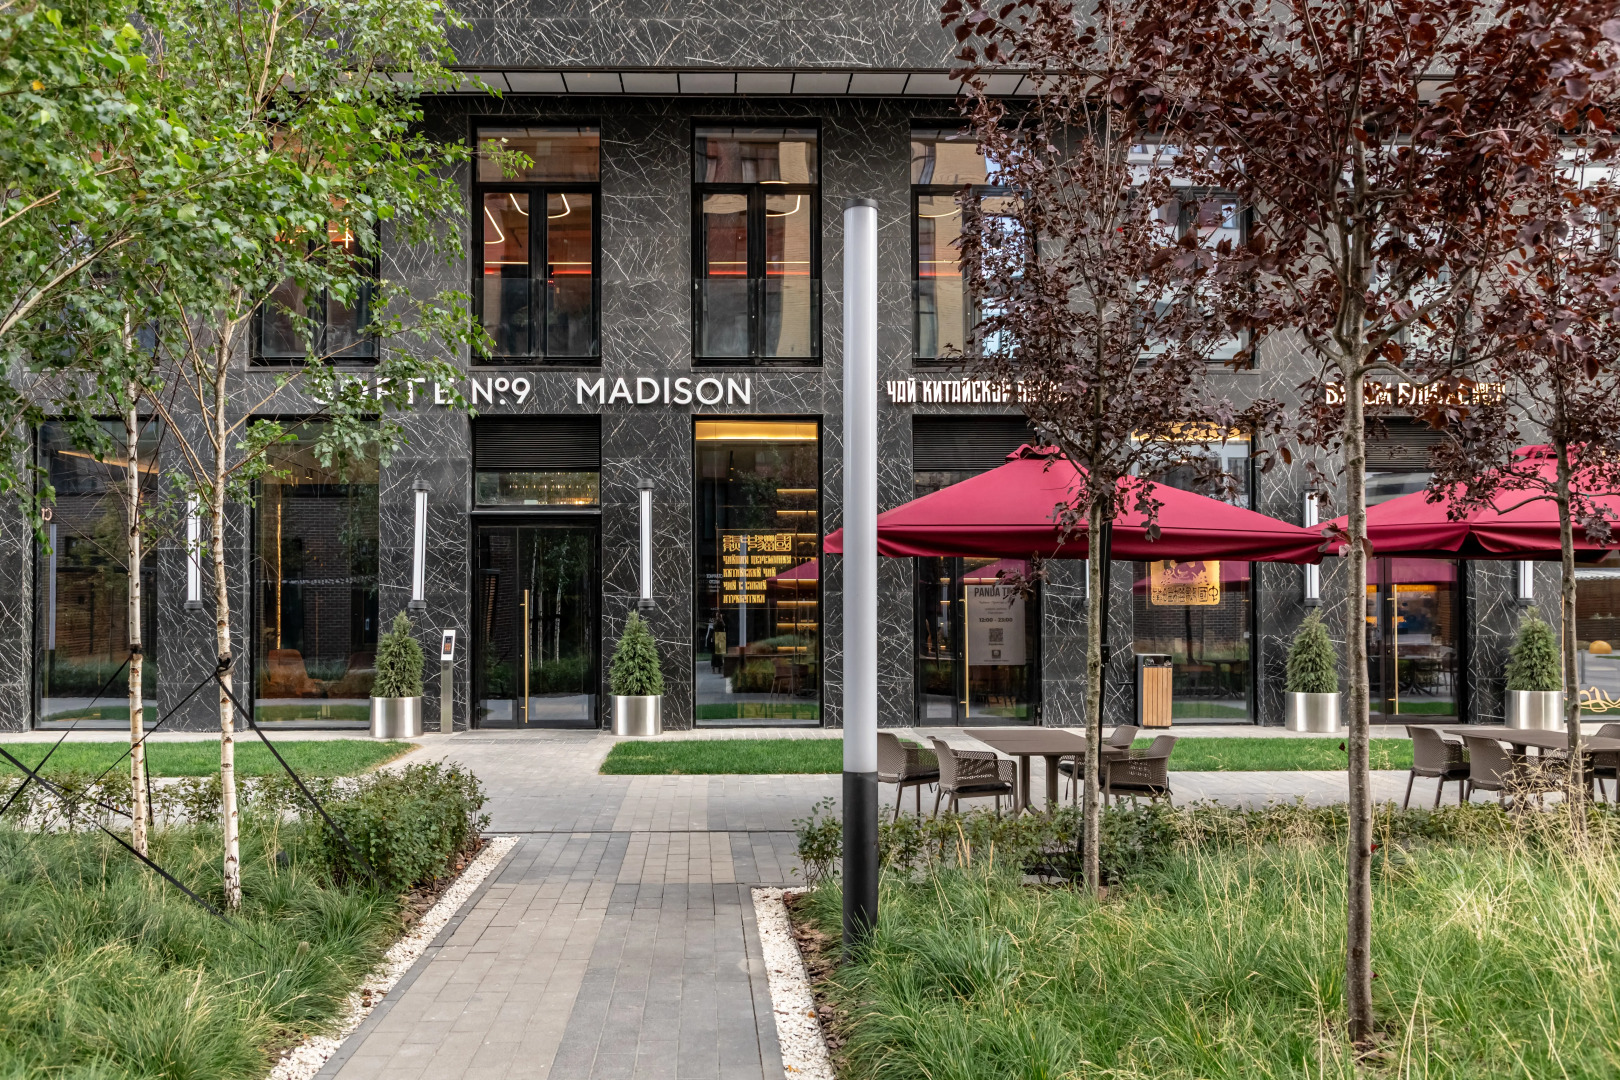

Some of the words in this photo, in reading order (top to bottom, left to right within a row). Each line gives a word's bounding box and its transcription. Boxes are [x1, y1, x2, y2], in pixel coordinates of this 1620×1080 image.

[576, 377, 751, 405] MADISON
[886, 377, 917, 403] ЧАЙ
[923, 377, 1011, 403] КИТАЙСКОЙ
[974, 587, 1000, 597] PANDA
